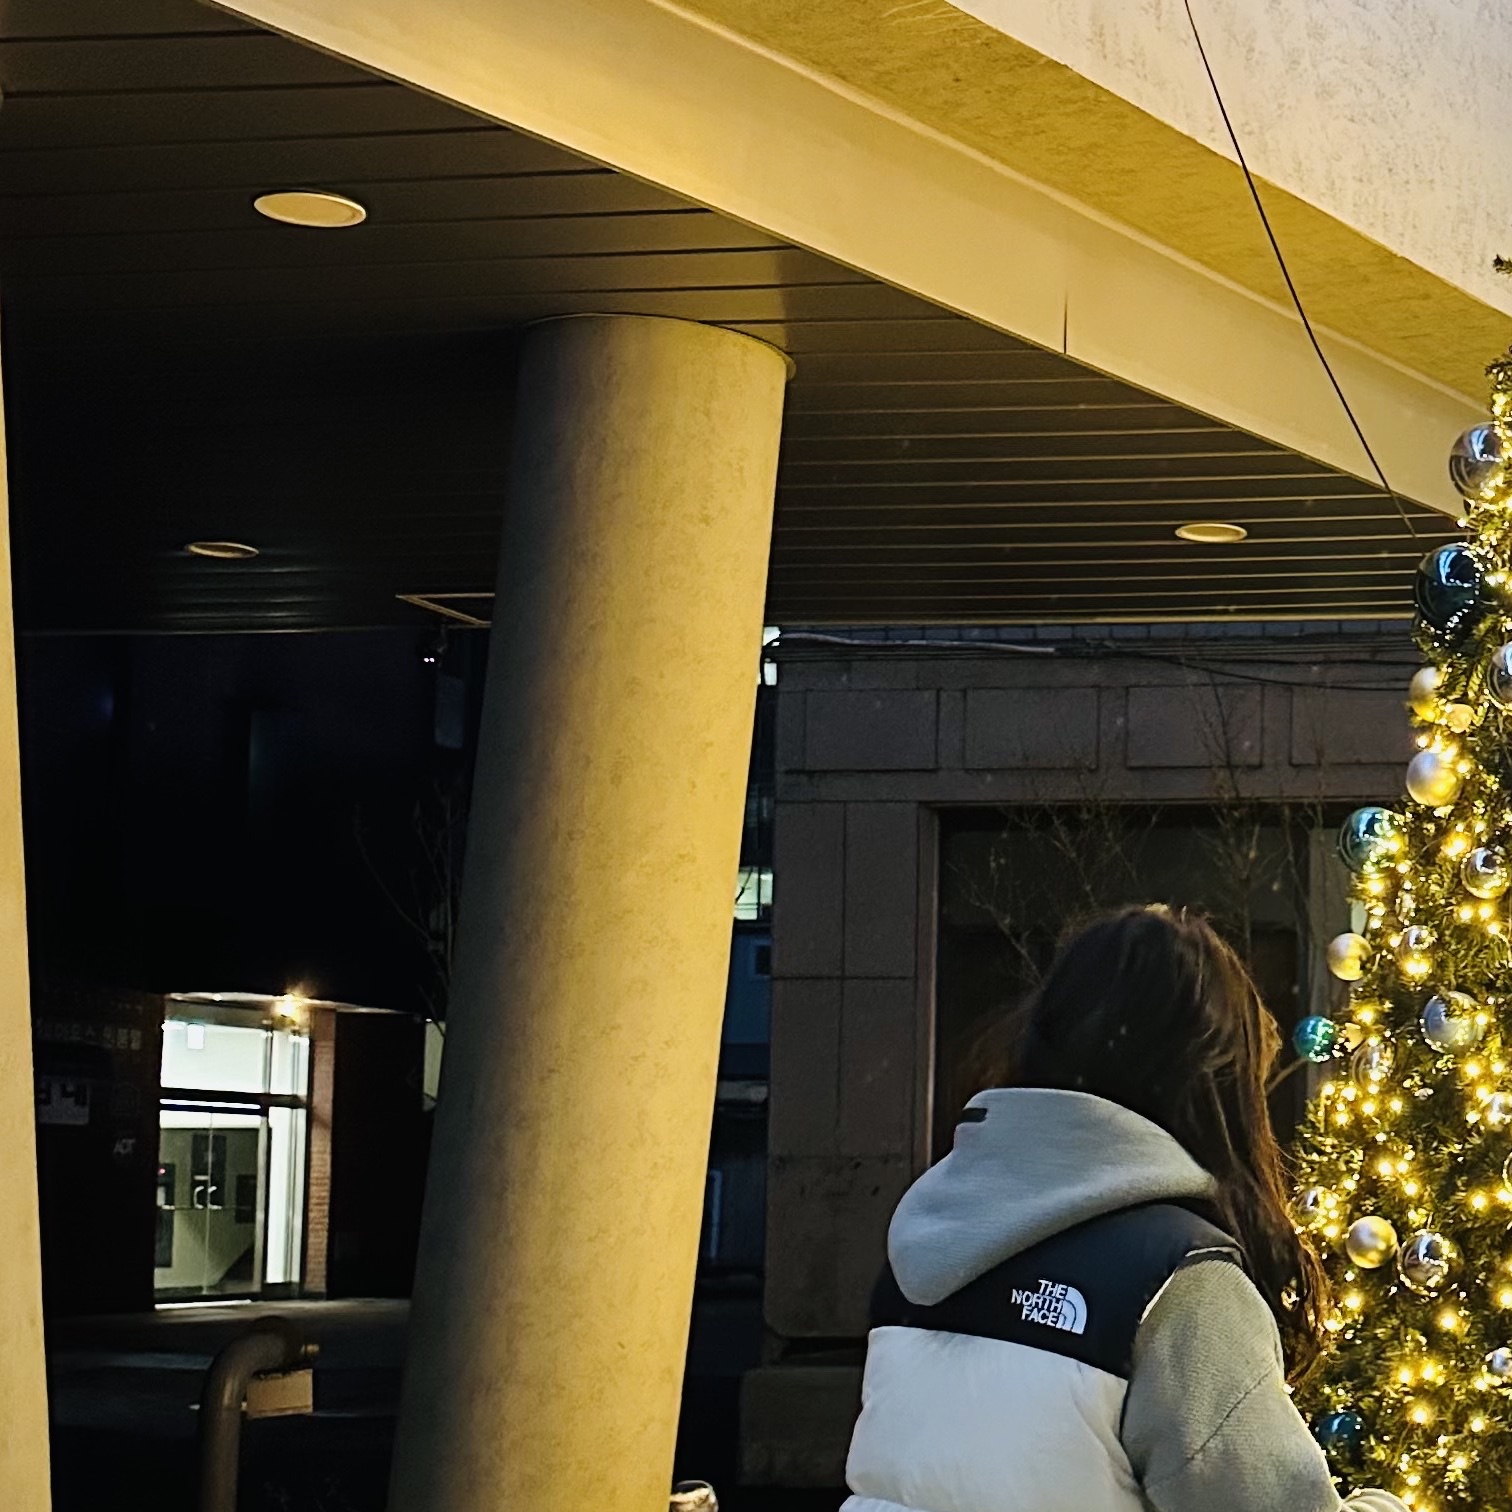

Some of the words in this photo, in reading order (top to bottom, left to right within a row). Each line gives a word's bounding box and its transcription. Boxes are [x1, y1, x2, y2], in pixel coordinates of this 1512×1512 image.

[1038, 1279, 1068, 1299] THE
[1010, 1288, 1064, 1313] NORTH
[1021, 1305, 1059, 1327] FACE
